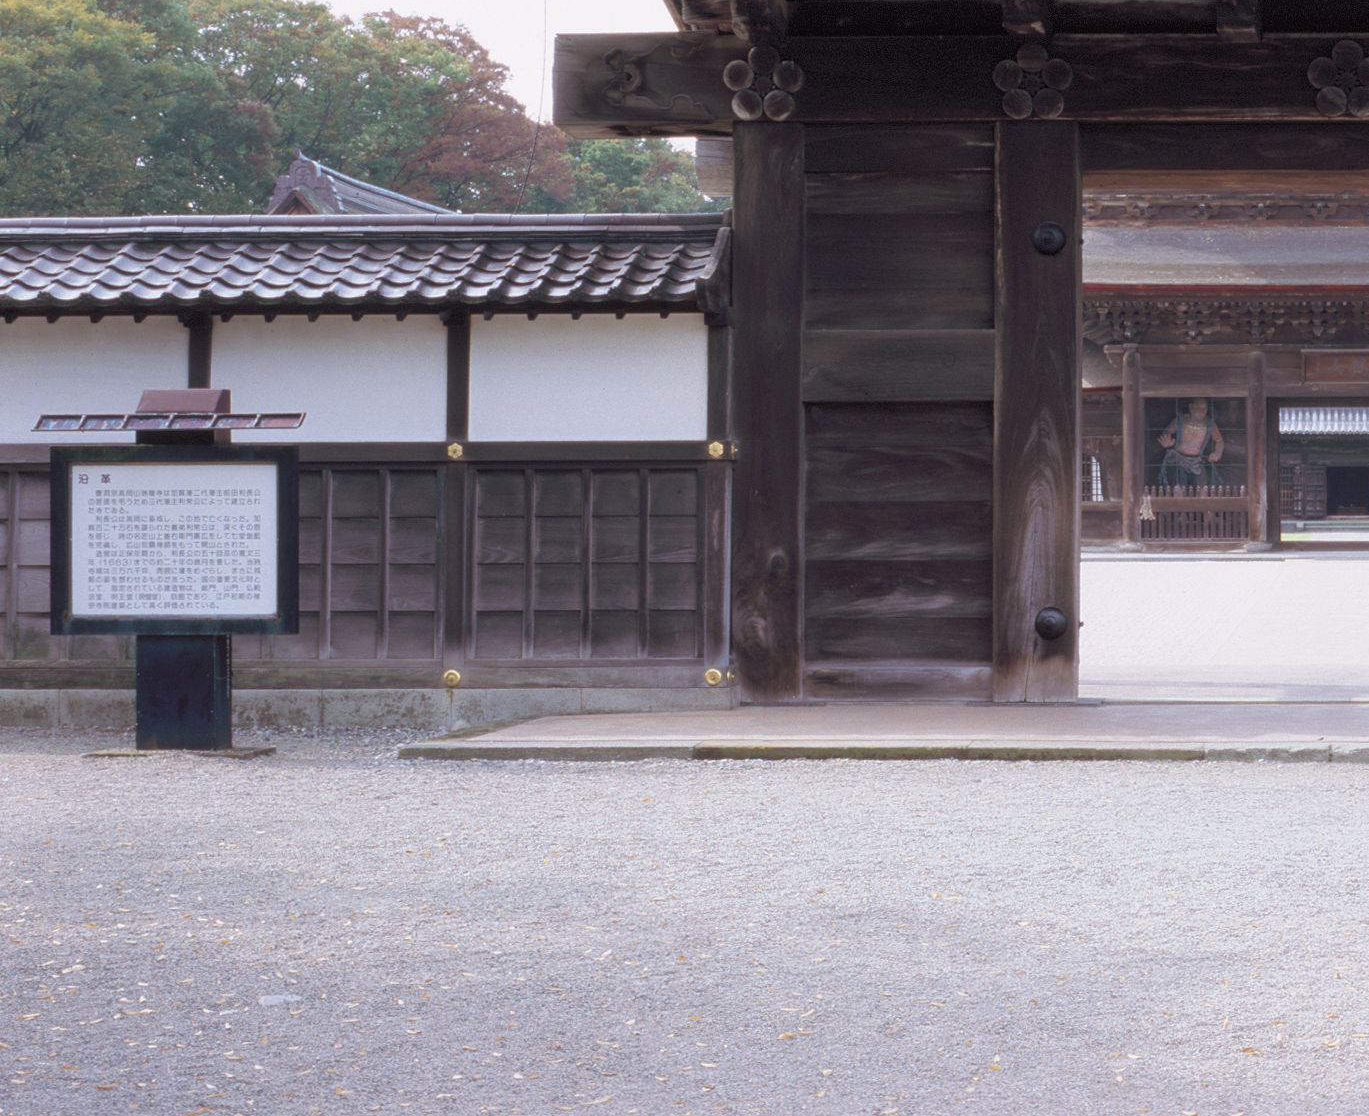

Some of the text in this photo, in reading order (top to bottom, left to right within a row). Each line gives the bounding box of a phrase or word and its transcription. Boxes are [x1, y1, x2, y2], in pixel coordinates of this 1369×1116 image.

[88, 507, 129, 515] た寺である。
